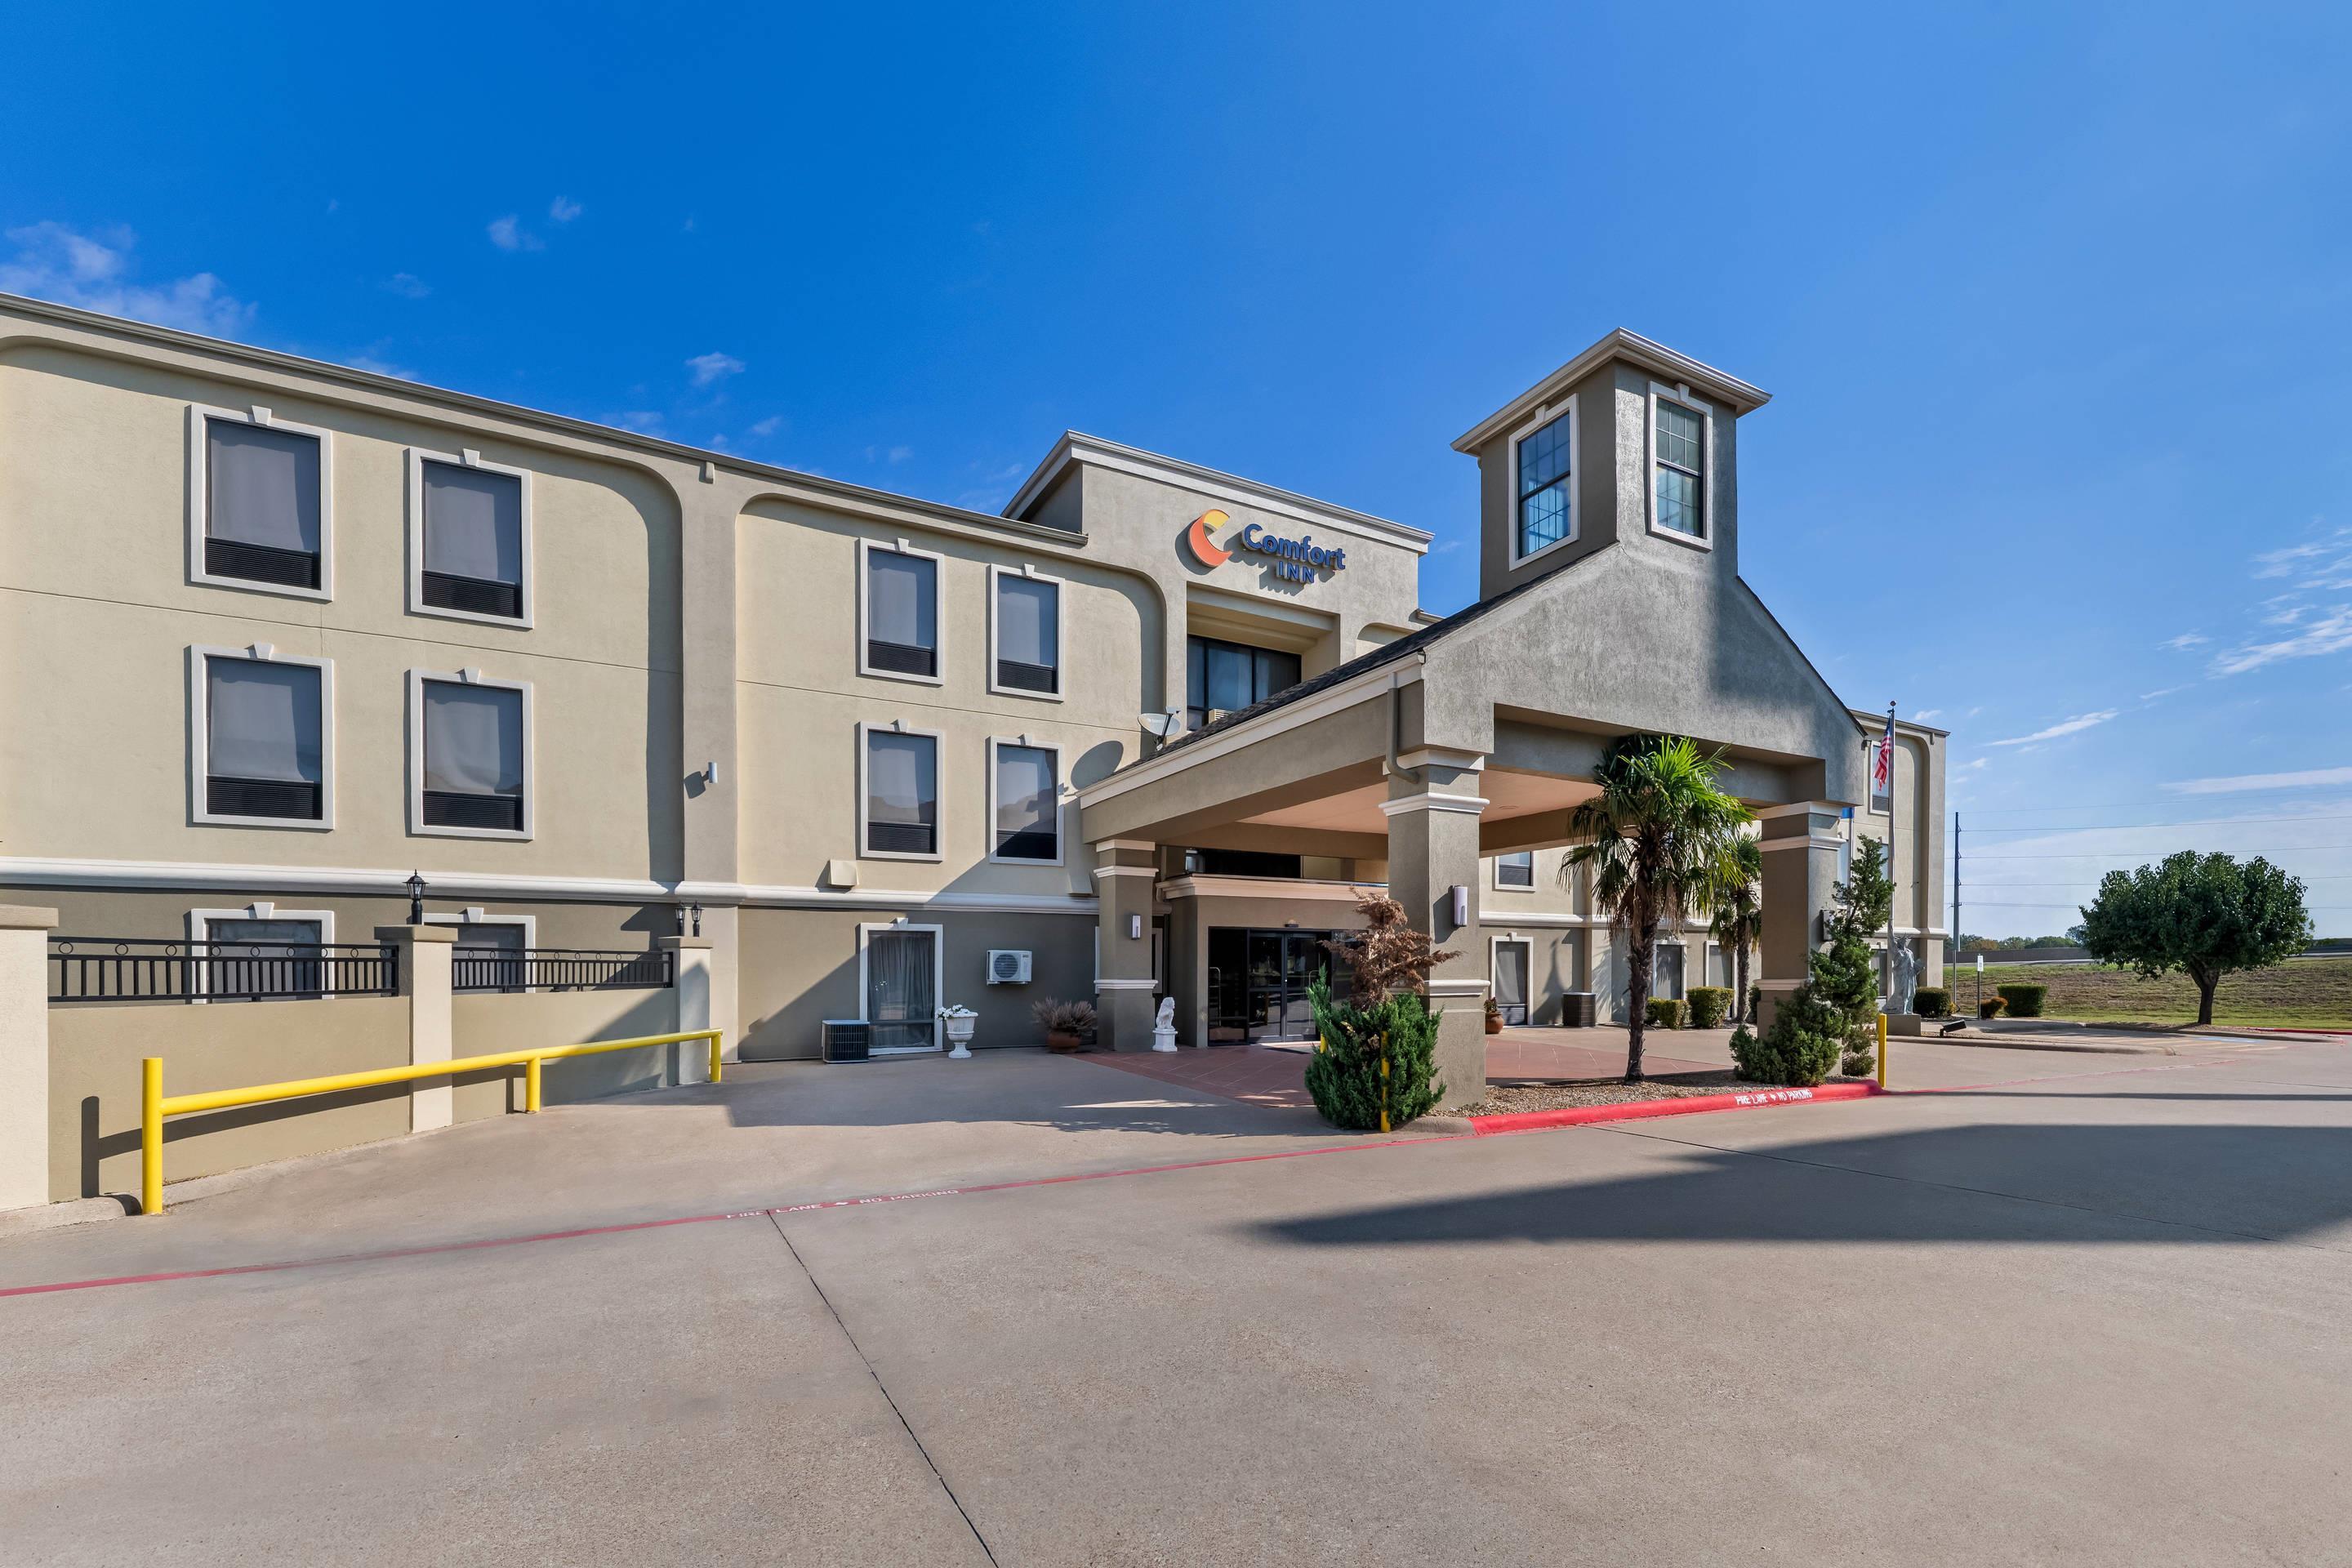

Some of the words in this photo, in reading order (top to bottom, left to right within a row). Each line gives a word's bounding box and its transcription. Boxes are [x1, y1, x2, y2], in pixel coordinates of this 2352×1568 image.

[1241, 523, 1346, 570] Comfort
[1276, 561, 1315, 584] INN
[1735, 1096, 1750, 1105] FIRE
[1751, 1094, 1768, 1103] LANE
[1776, 1092, 1787, 1101] NO
[1787, 1089, 1812, 1101] PARKING
[775, 1204, 823, 1214] LANE
[890, 1189, 959, 1200] PARKING
